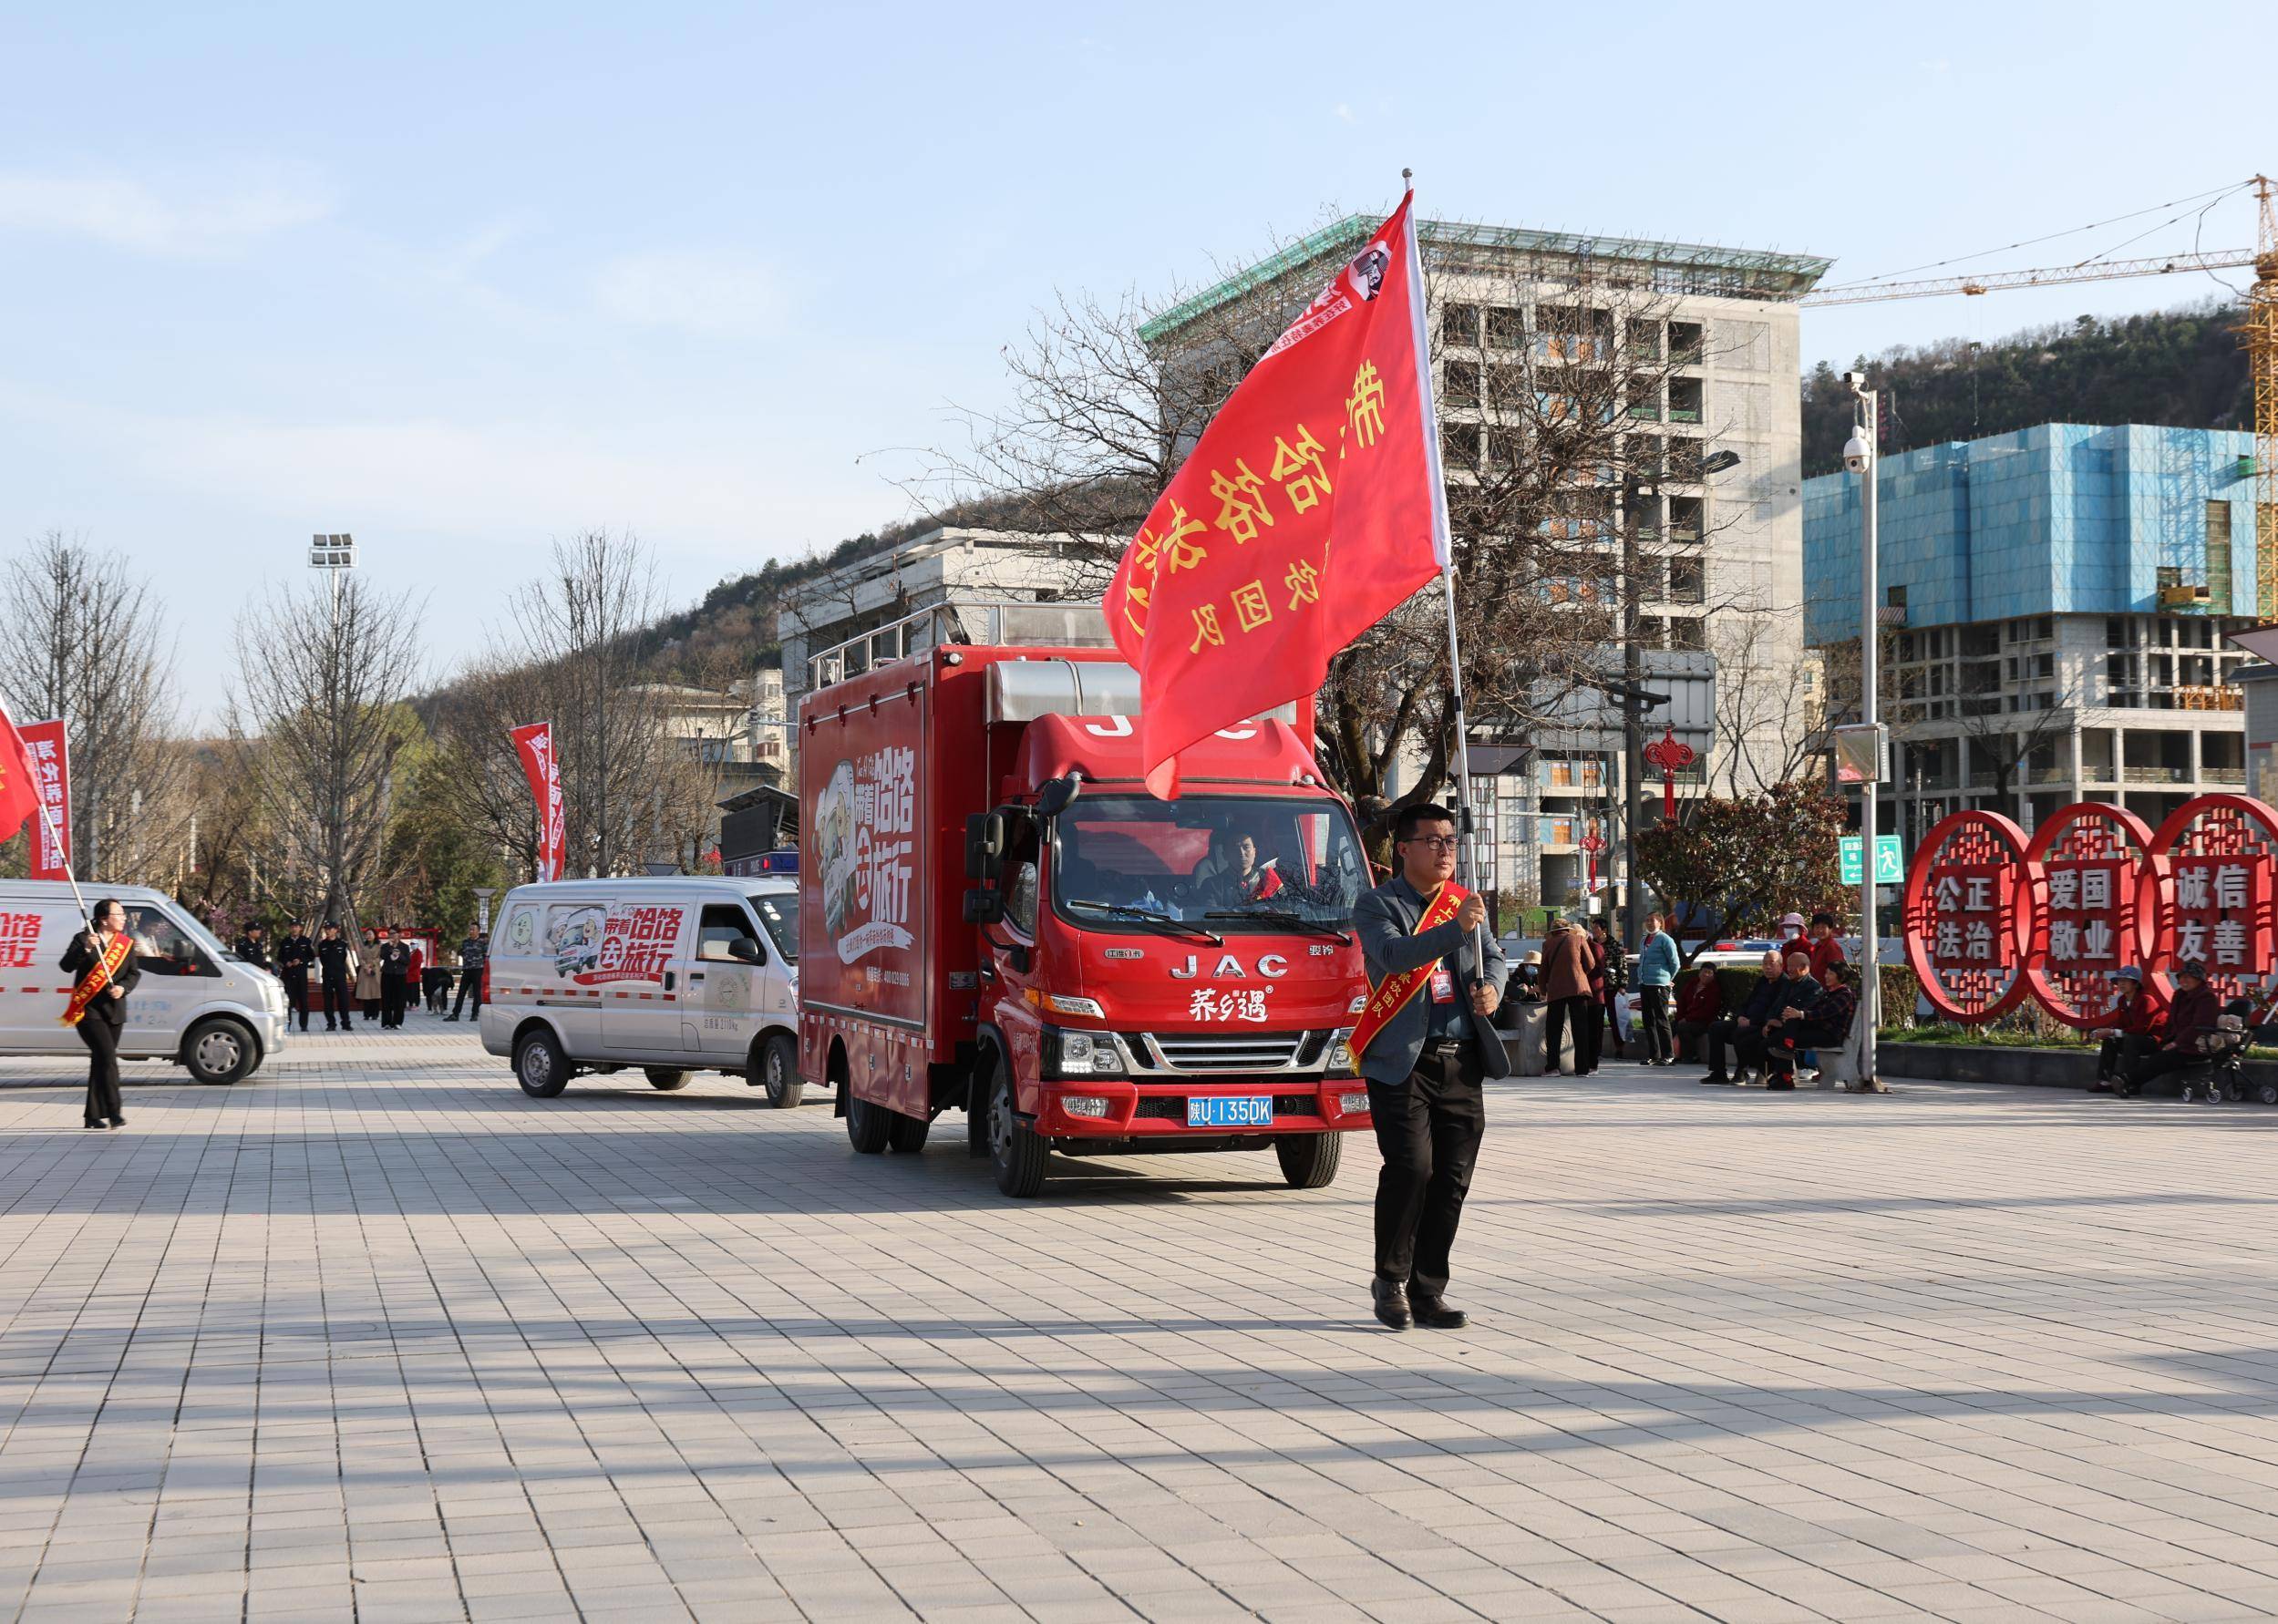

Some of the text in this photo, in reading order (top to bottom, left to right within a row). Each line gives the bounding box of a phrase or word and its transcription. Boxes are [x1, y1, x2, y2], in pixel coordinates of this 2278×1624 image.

[855, 745, 914, 835] 带着饸饹
[856, 826, 913, 924] 去旅行
[1934, 878, 1994, 911] 公正
[2048, 869, 2111, 910] 爱国
[2176, 864, 2250, 910] 诚信
[604, 908, 684, 940] 带着饸饹
[1935, 921, 1994, 961] 法治
[2048, 920, 2114, 961] 敬业
[2176, 921, 2247, 965] 友善
[600, 936, 675, 973] 去旅行
[1171, 955, 1288, 979] JAC
[1190, 1101, 1270, 1122] 陕U·135DK
